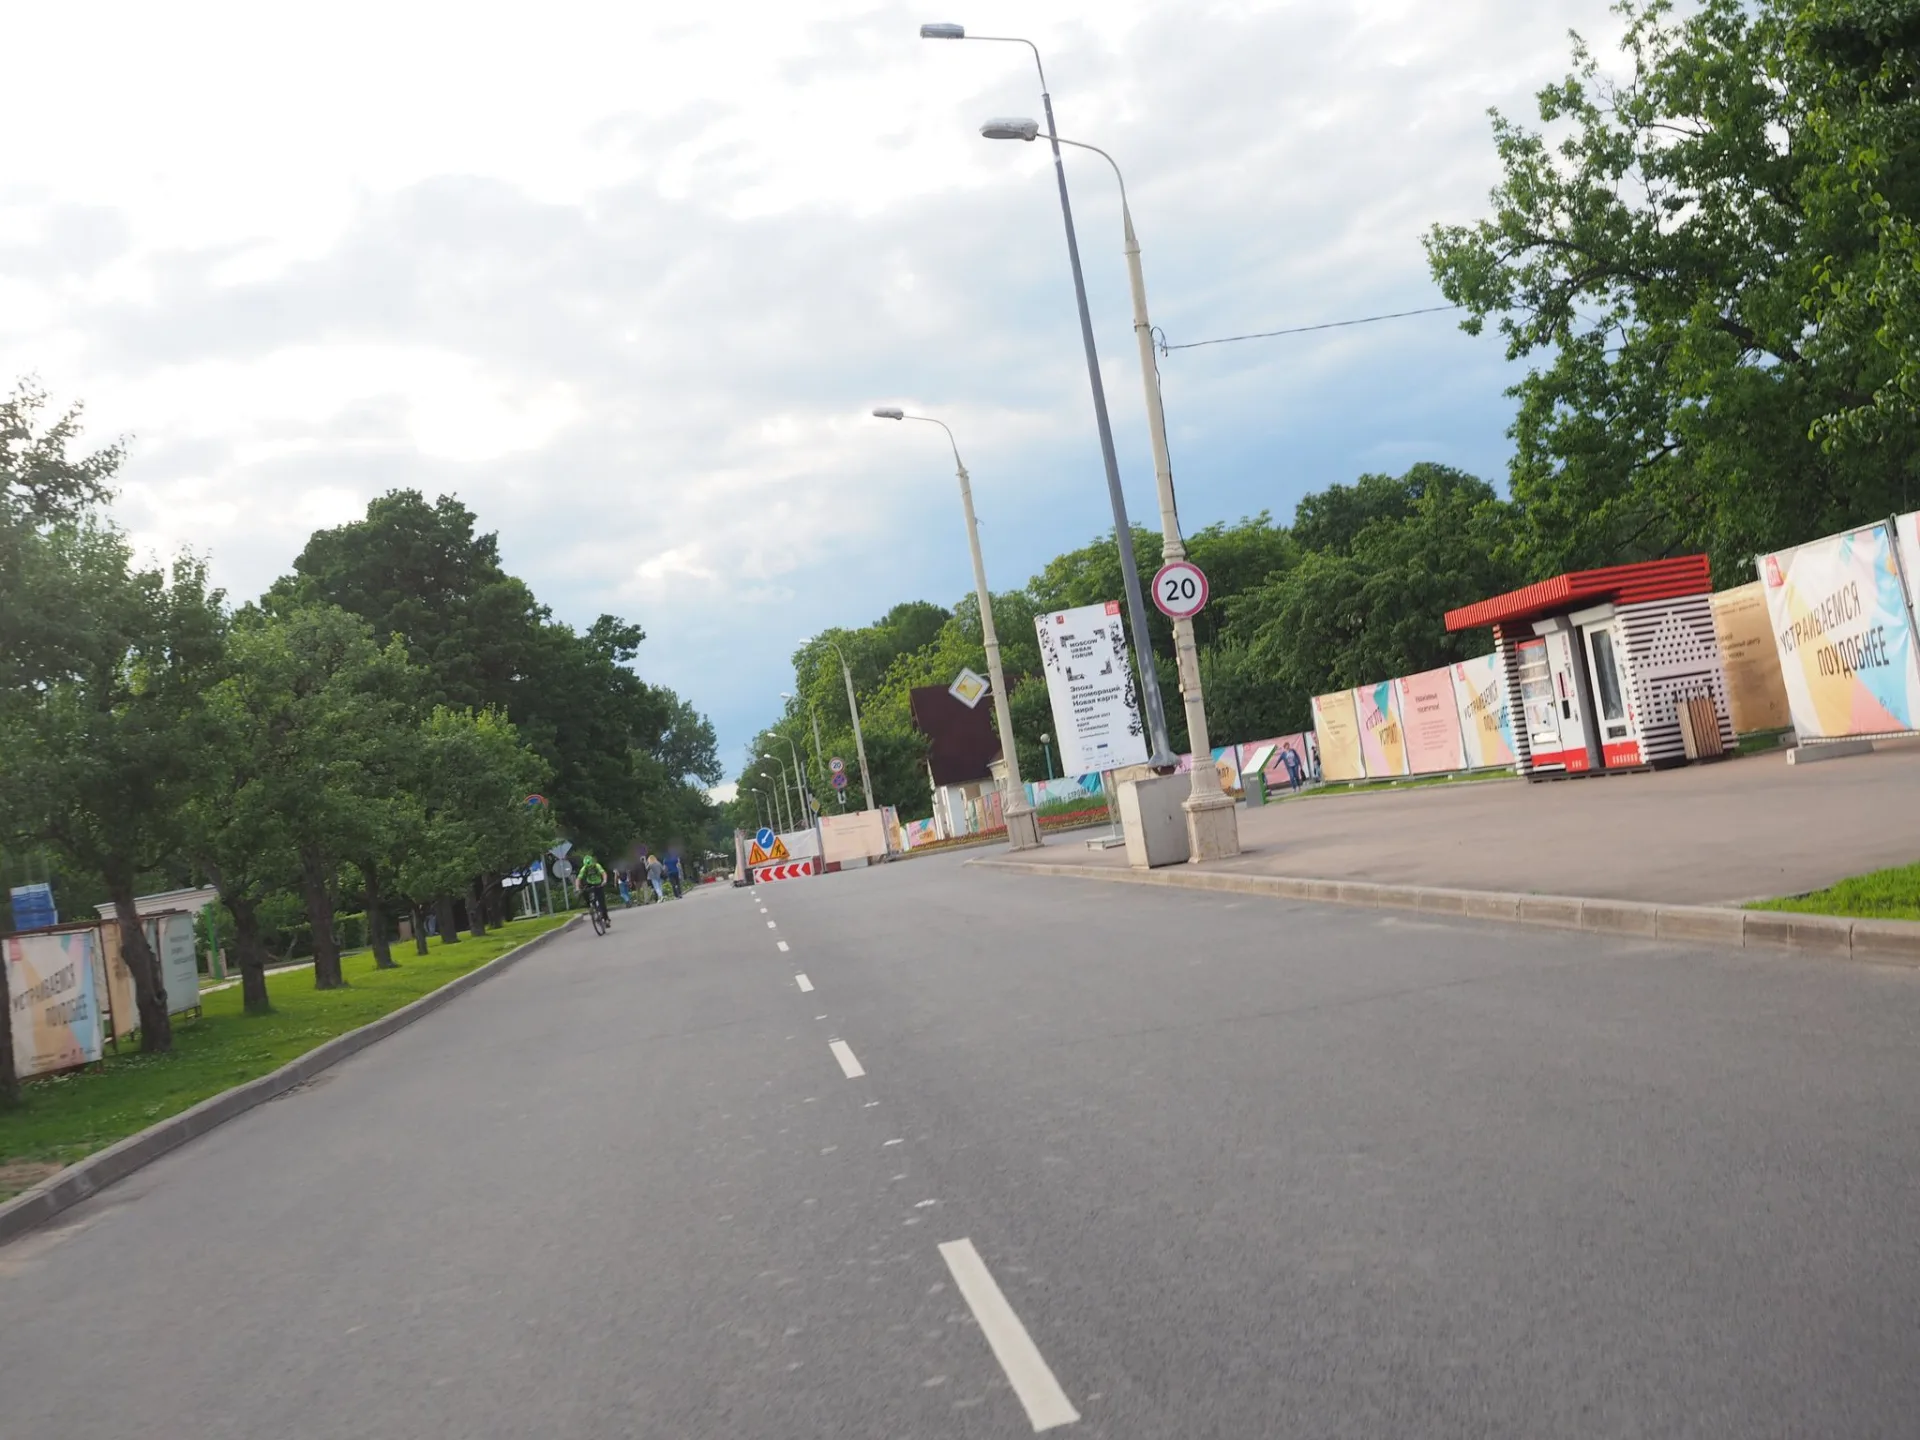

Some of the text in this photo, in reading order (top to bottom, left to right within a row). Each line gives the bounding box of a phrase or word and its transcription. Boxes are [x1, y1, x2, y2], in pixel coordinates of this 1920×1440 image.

[1165, 577, 1196, 601] 20
[1780, 581, 1862, 655] УСТРАИВАЕМСЯ
[1069, 638, 1098, 648] MOSCOW
[1070, 645, 1092, 653] URBAN
[1817, 625, 1890, 679] ПОУДОБНЕЕ
[1071, 651, 1094, 660] FORUM
[1069, 684, 1094, 693] Эпоха
[1072, 694, 1119, 707] Новая карта
[1074, 706, 1094, 715] мира
[831, 761, 842, 769] 20
